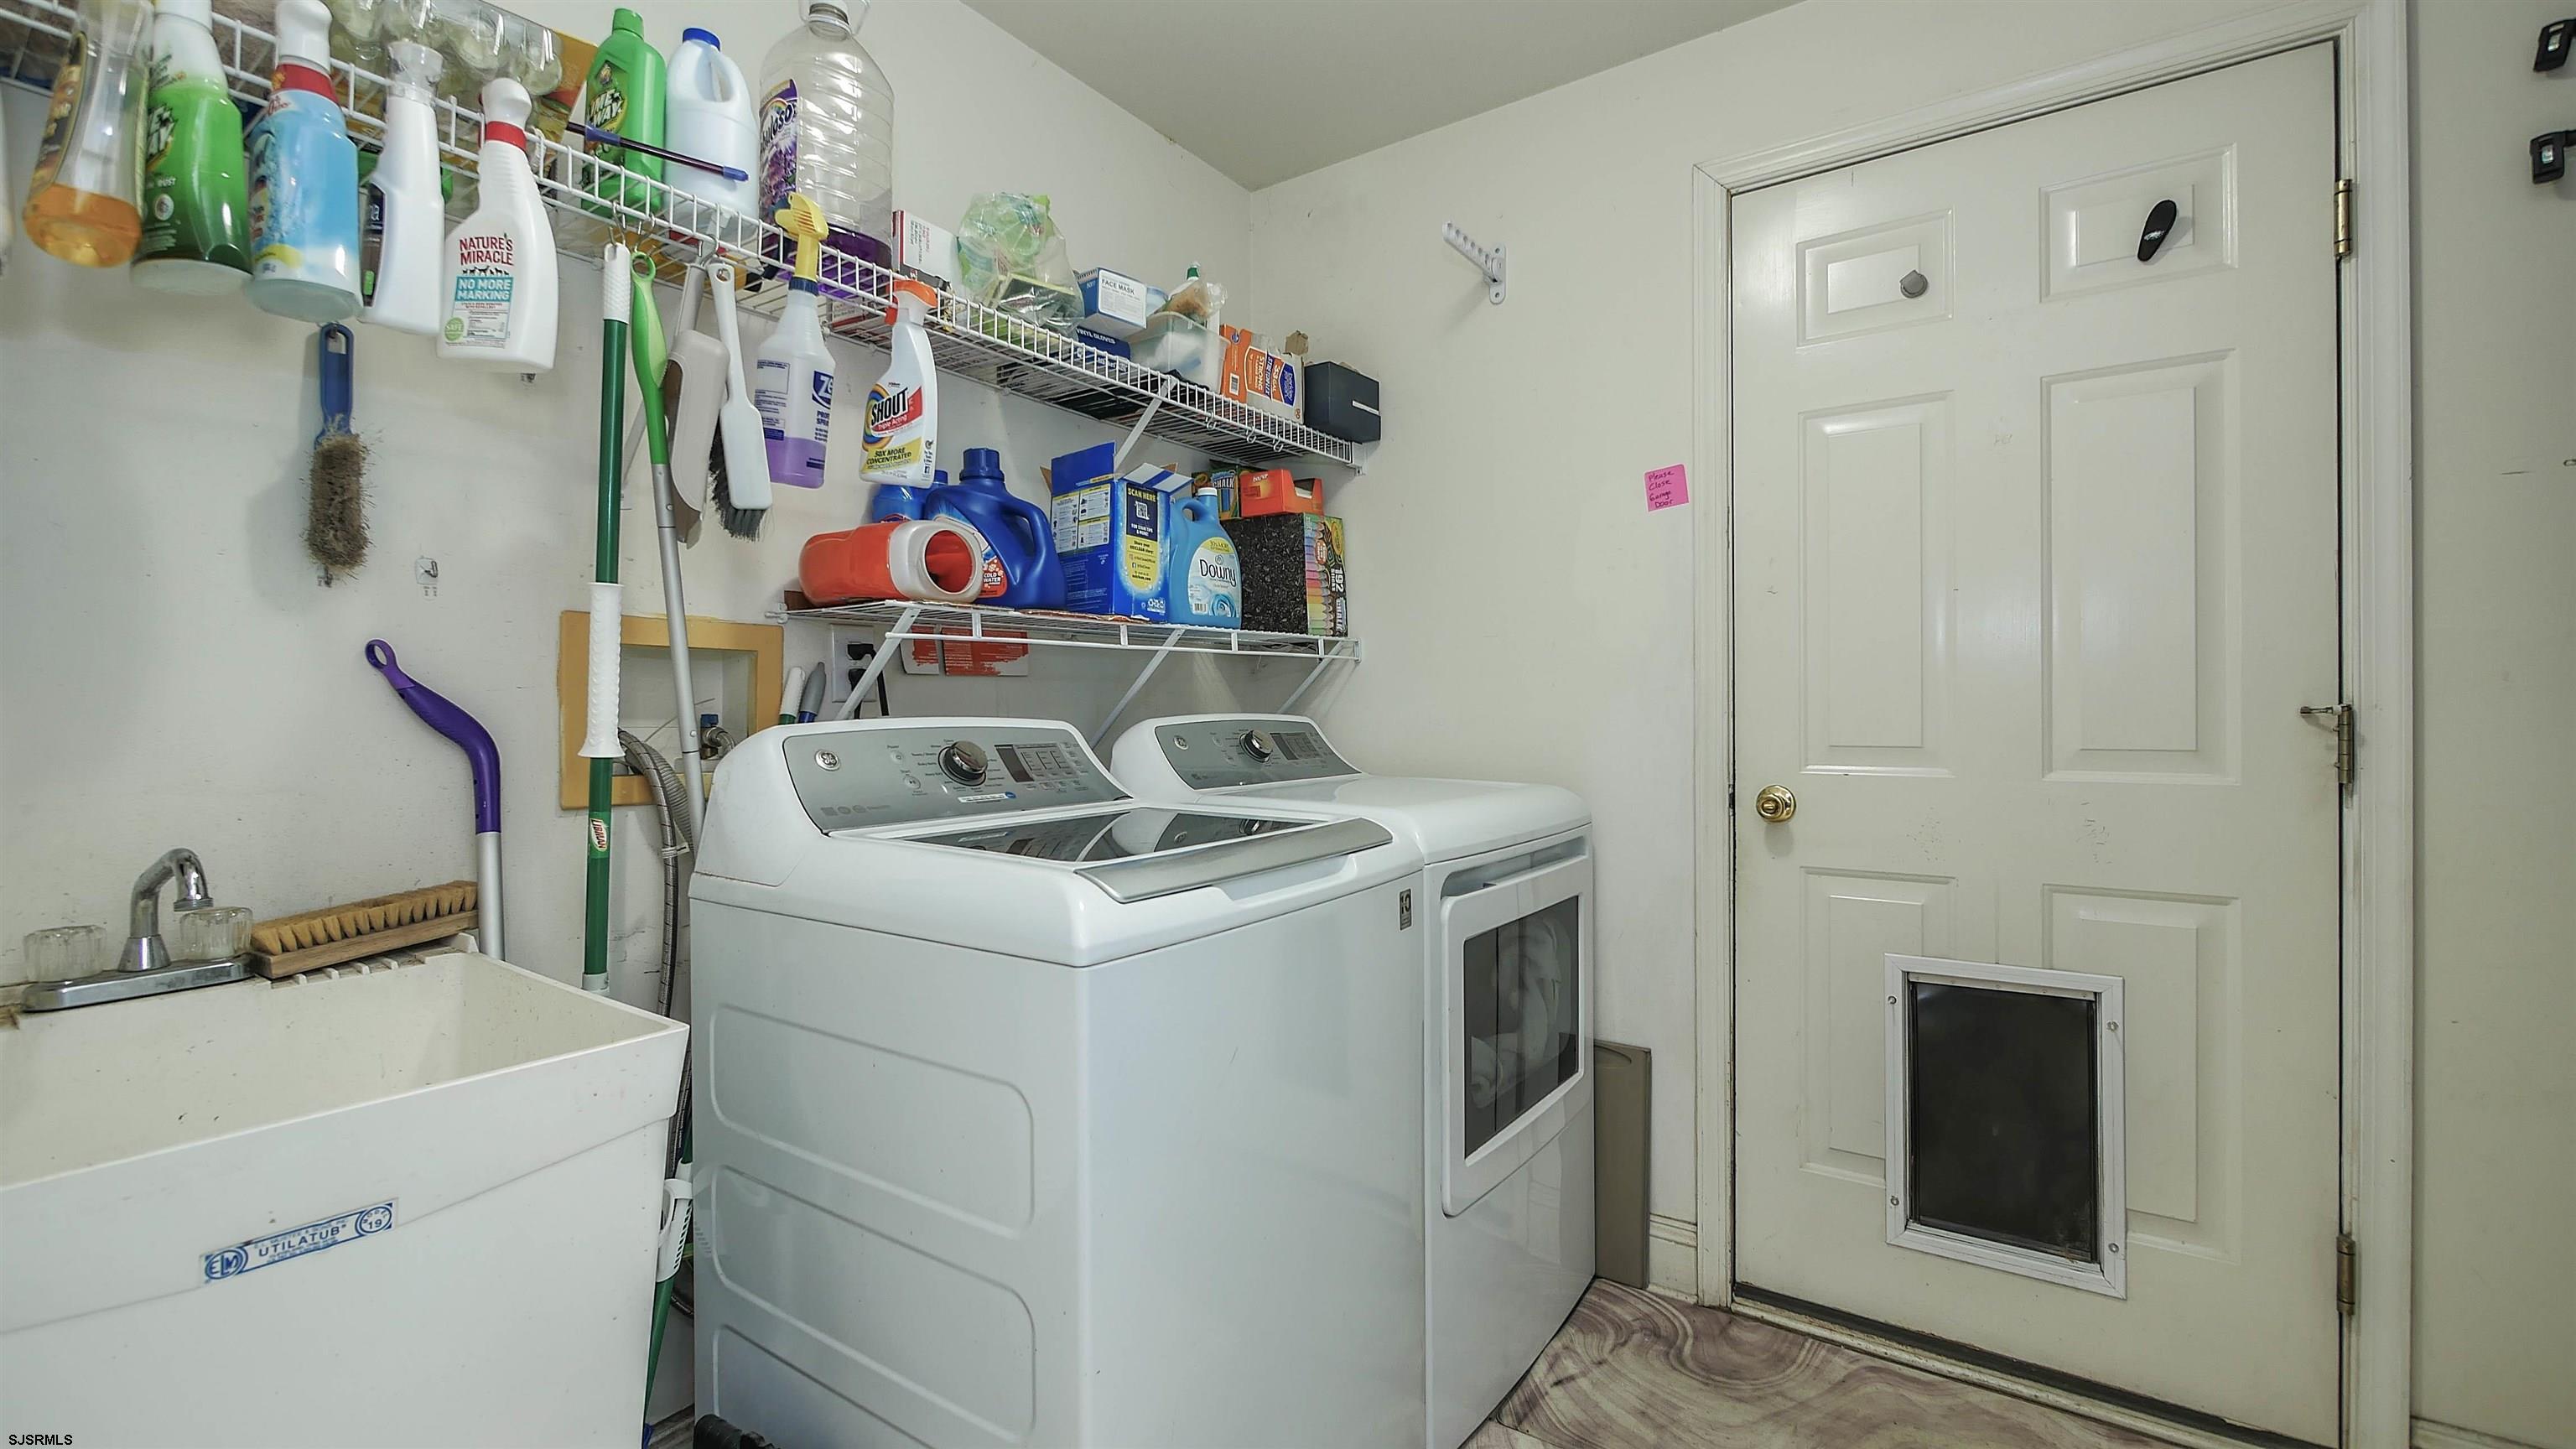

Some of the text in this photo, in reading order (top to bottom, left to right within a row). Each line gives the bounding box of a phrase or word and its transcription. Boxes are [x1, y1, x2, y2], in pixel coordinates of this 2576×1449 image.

[460, 235, 513, 252] NATURE'S
[460, 251, 514, 266] MIRACLE
[458, 278, 511, 291] NO MORE
[1101, 279, 1116, 288] FACE
[1118, 284, 1135, 295] MASK
[457, 290, 510, 301] MARKING
[1076, 328, 1116, 345] VINYL GLOVES
[871, 387, 909, 426] SHOUT
[866, 452, 912, 465] CONCENTRATED
[887, 447, 906, 456] MORE
[1213, 476, 1235, 490] CHALK
[1649, 479, 1673, 491] Close
[1128, 487, 1156, 503] SCAN HERE
[1199, 558, 1237, 588] Downy
[1335, 567, 1343, 592] 192
[366, 1218, 382, 1230] 19
